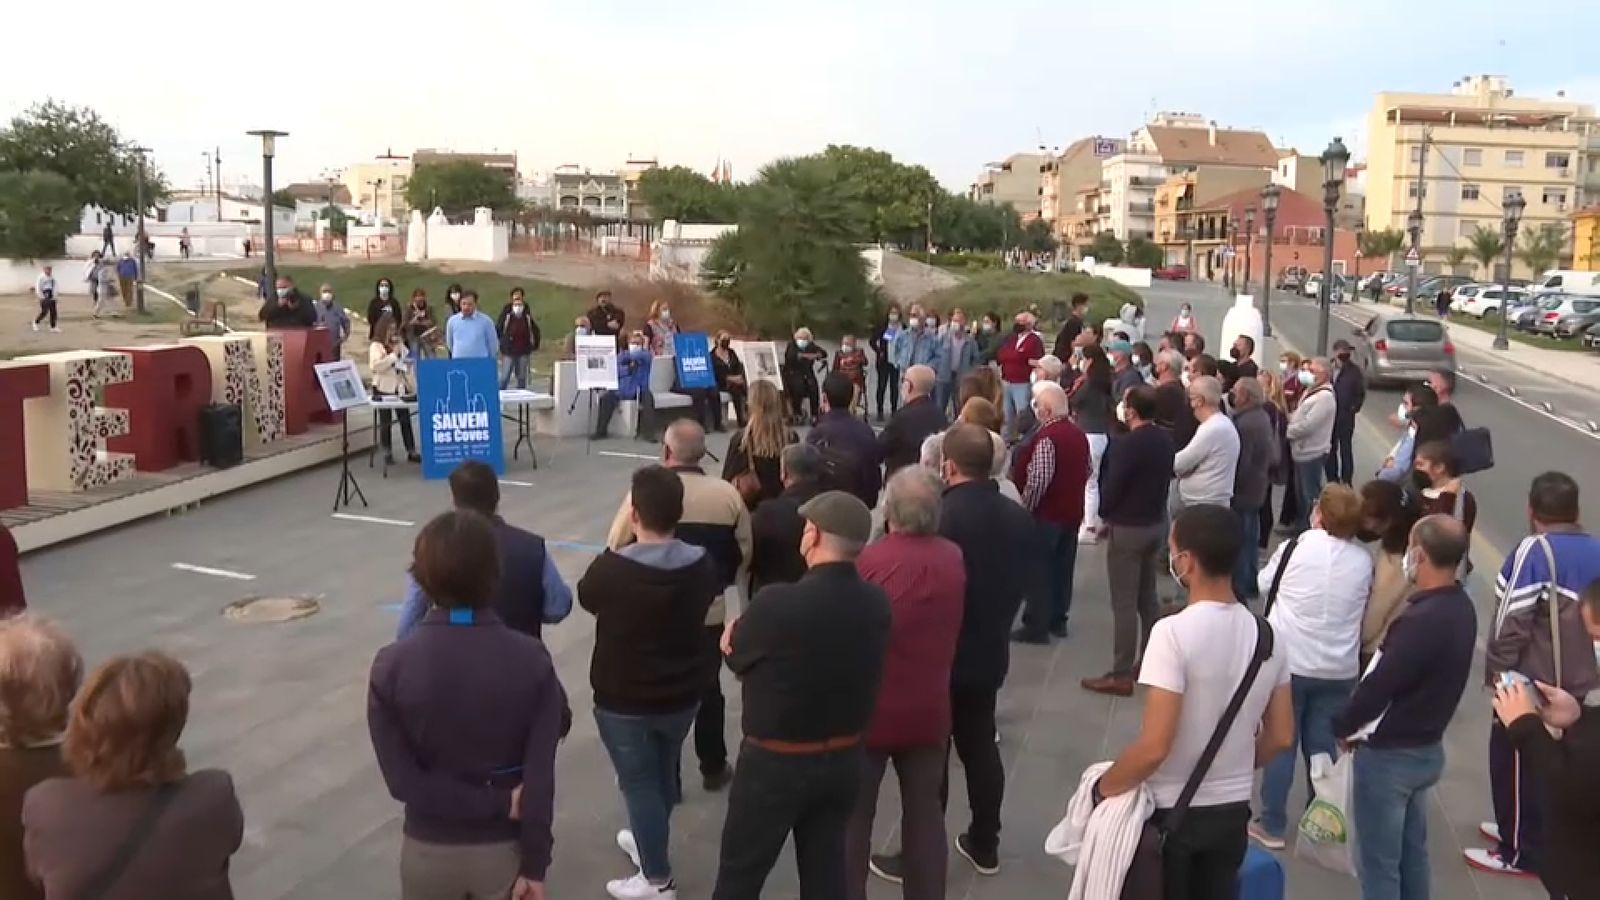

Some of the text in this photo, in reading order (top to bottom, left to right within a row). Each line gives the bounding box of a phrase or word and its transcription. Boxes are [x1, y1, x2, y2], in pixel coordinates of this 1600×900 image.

[432, 411, 489, 431] SALVEM
[433, 429, 490, 443] les Coves
